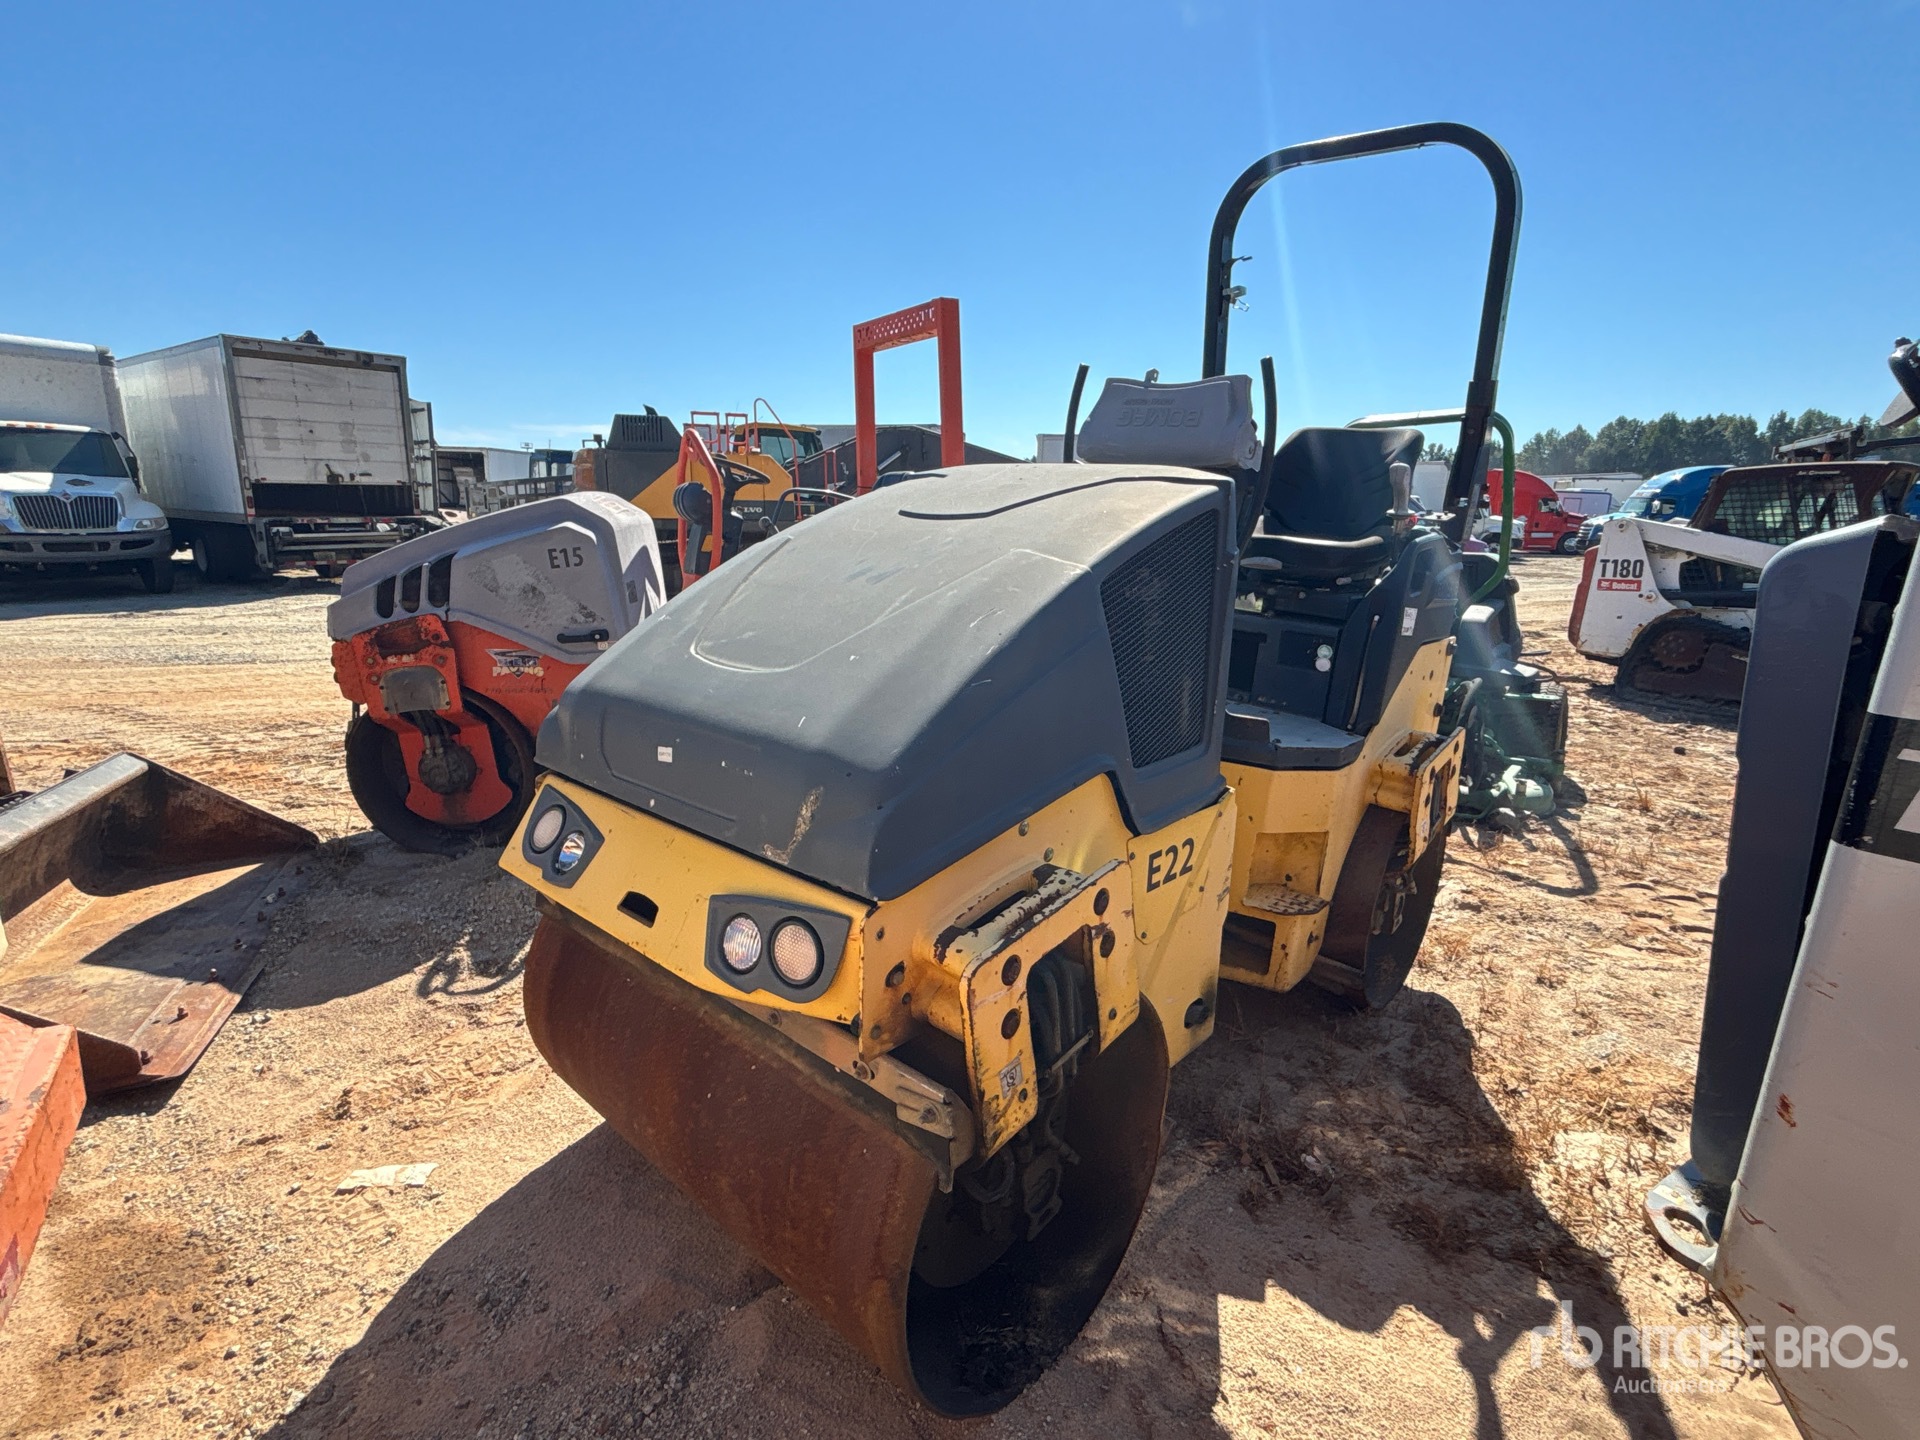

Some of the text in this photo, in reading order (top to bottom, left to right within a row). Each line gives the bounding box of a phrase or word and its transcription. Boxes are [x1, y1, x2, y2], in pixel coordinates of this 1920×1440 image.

[547, 546, 584, 569] E15
[1599, 558, 1645, 579] T180
[1611, 581, 1638, 590] Bobcat
[1146, 837, 1195, 893] E22
